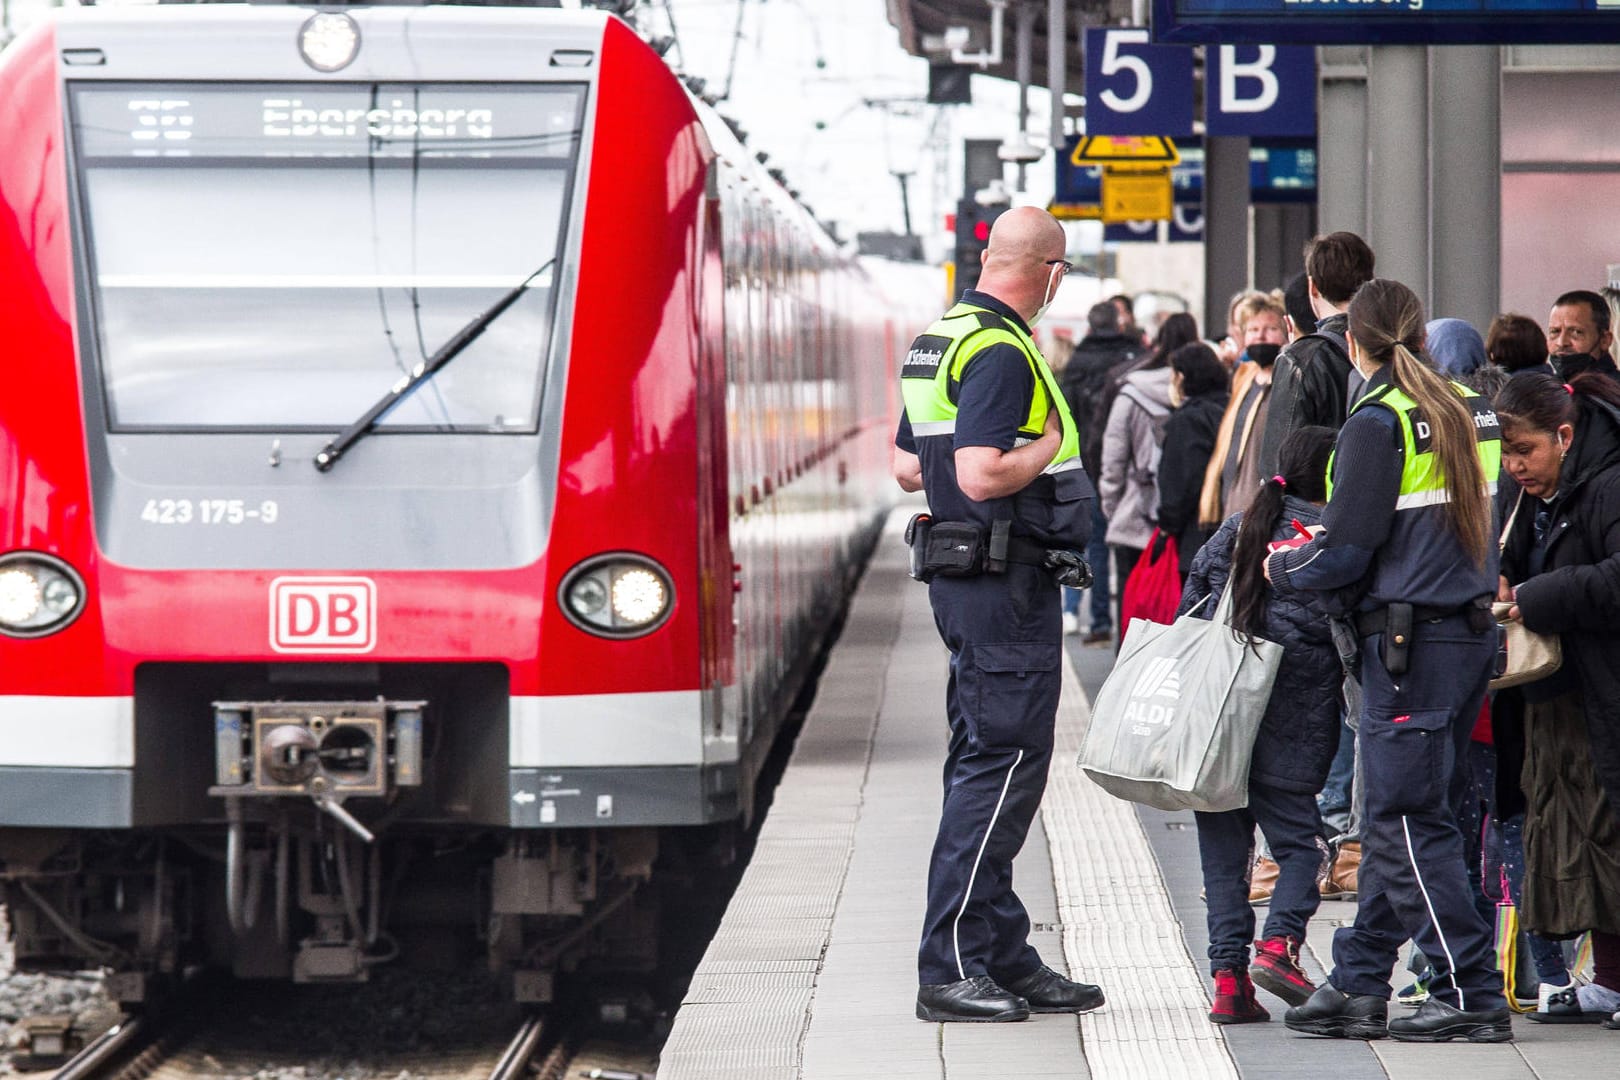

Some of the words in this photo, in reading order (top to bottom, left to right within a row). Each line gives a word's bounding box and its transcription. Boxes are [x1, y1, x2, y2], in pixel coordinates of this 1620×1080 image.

[1100, 30, 1153, 113] 5
[1220, 44, 1279, 113] B
[263, 99, 492, 138] Ebersberg
[1416, 421, 1431, 439] D
[1474, 410, 1499, 428] rheit
[141, 499, 193, 523] 423
[199, 499, 279, 523] 175-9
[288, 592, 360, 637] DB
[1123, 701, 1175, 727] ALDI
